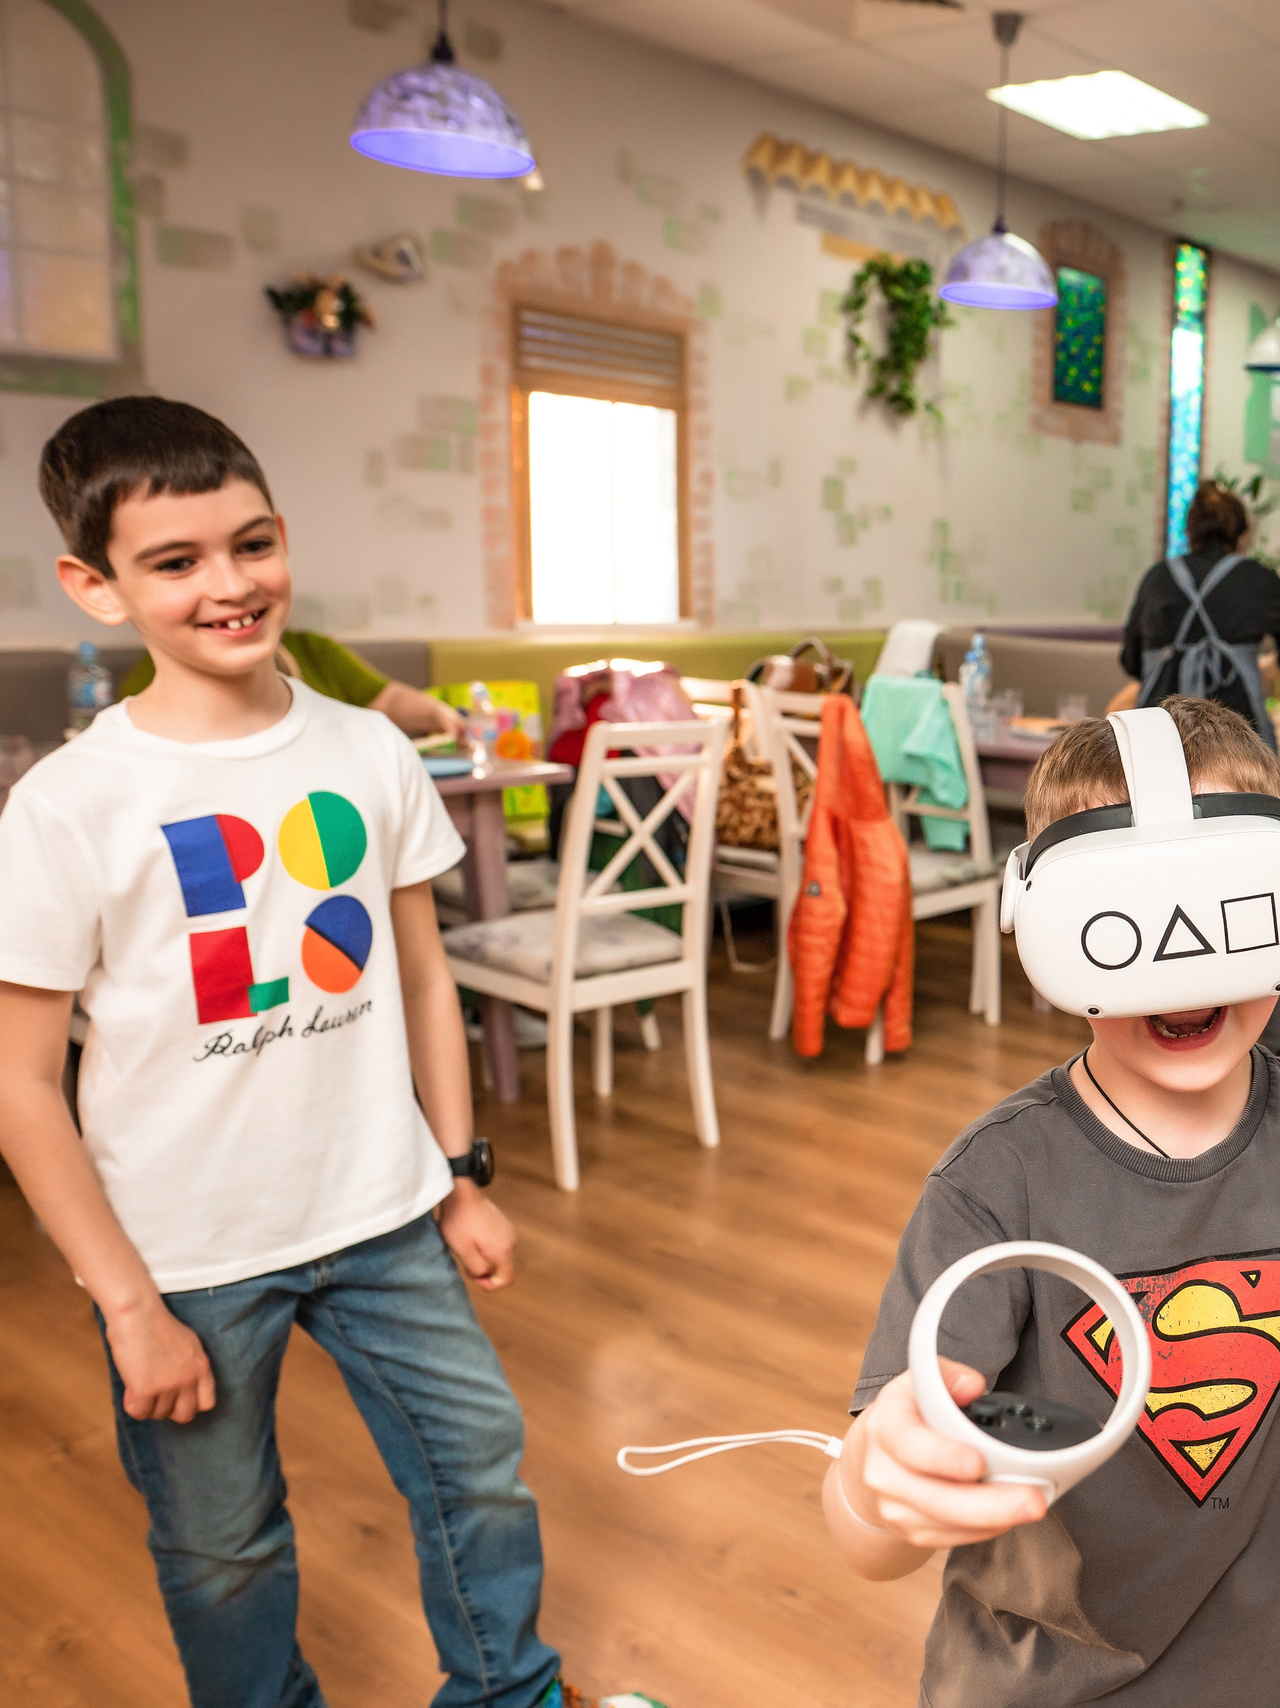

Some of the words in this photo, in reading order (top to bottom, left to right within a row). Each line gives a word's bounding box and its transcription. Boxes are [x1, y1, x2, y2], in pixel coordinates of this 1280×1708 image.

[192, 1014, 293, 1062] Ralph
[300, 998, 374, 1038] Lauren
[1210, 1497, 1230, 1510] TM
